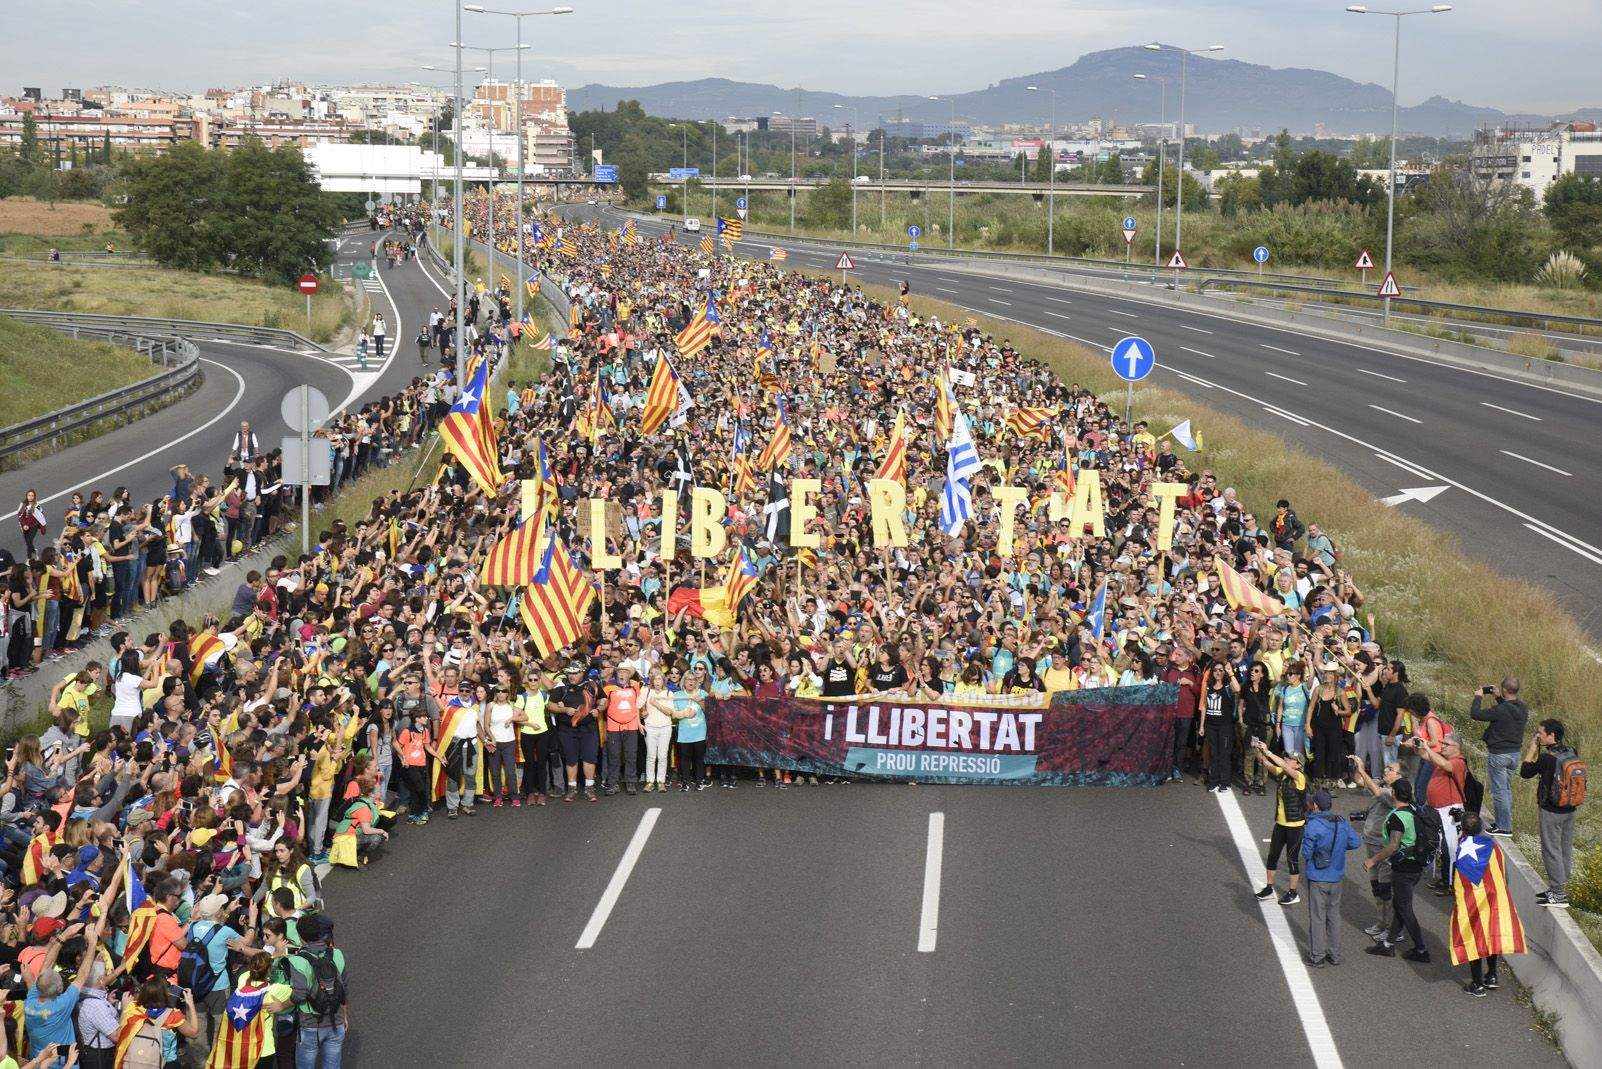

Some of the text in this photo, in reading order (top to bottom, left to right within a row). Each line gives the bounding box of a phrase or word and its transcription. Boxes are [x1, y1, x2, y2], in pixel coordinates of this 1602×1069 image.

[845, 705, 1043, 751] LLIBERTAT
[876, 752, 1001, 774] PROU REPRESSIÓ
